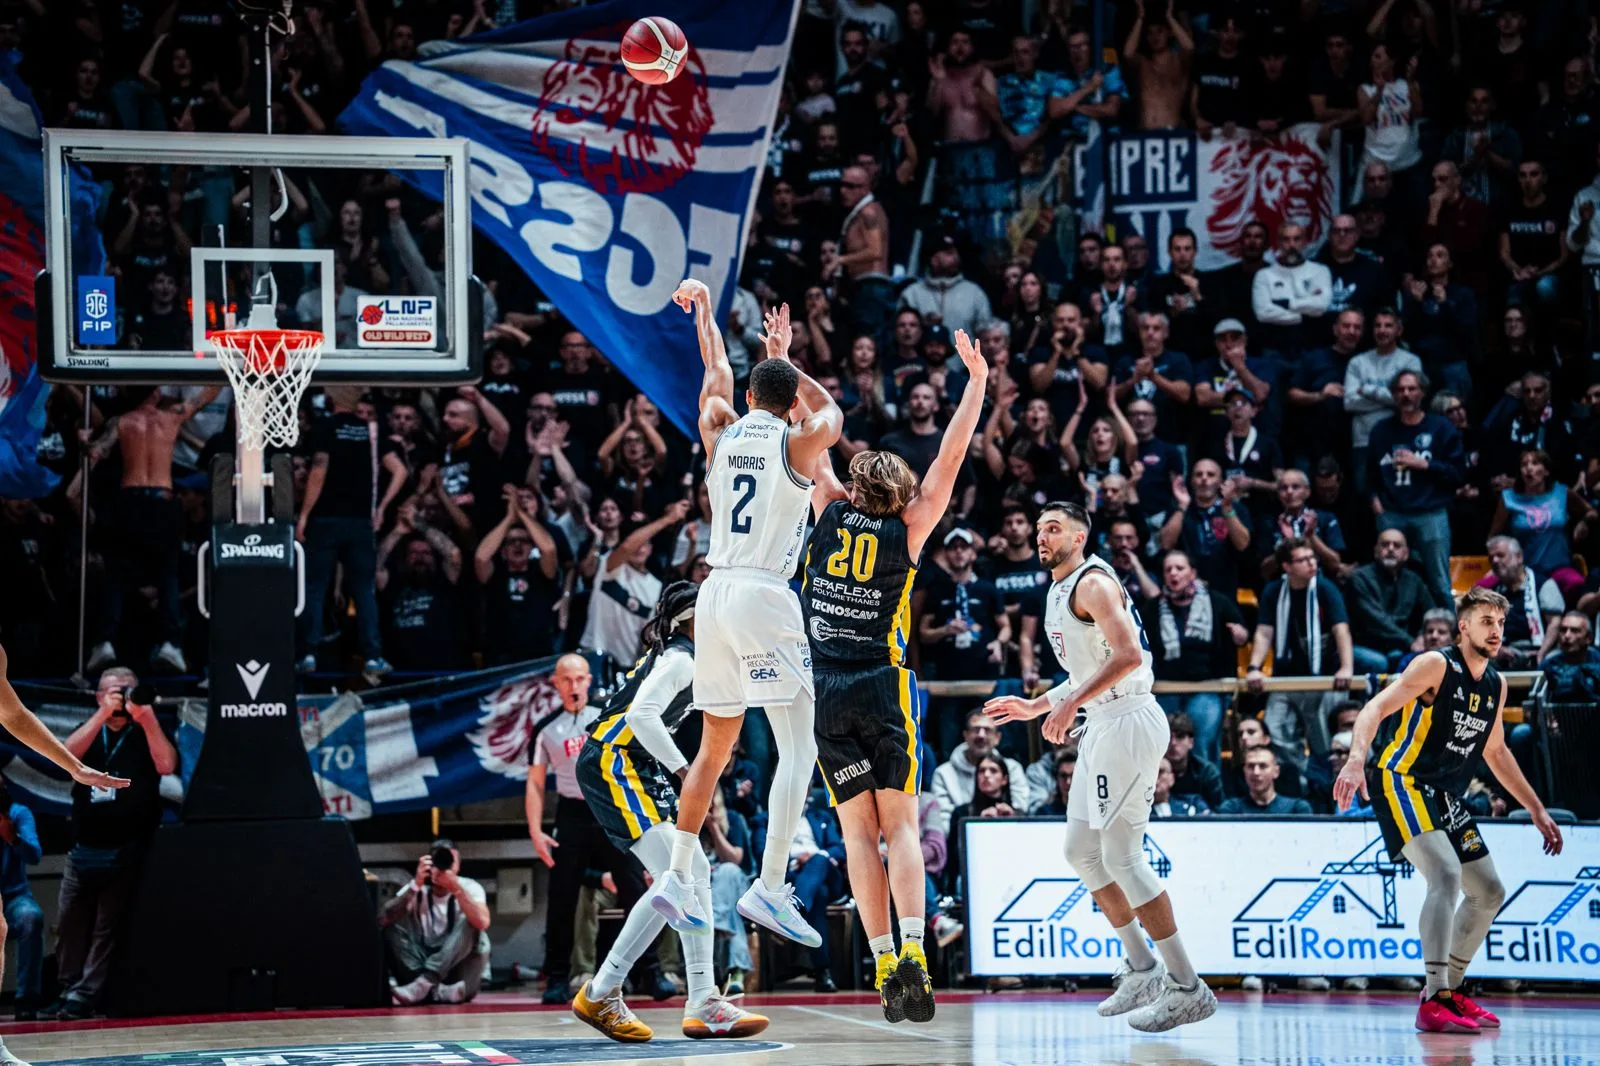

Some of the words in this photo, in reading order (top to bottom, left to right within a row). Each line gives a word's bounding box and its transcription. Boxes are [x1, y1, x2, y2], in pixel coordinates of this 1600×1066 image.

[385, 300, 432, 314] LNP
[82, 320, 112, 331] FIP
[364, 331, 382, 341] OLD
[383, 331, 405, 341] WILD
[405, 331, 429, 341] WEST
[67, 358, 110, 367] SPALDING
[743, 430, 769, 439] Innova
[728, 455, 766, 470] MORRIS
[731, 473, 757, 534] 2
[221, 543, 285, 559] SPALDING
[827, 527, 879, 583] 20
[813, 577, 872, 599] EPAFLEX
[813, 587, 880, 606] POLYURETHANES
[749, 667, 779, 680] GEA
[220, 702, 287, 718] macron
[1468, 692, 1481, 713] 13
[318, 744, 355, 771] 70
[1096, 774, 1108, 799] 8
[1232, 924, 1424, 959] EdilRomea
